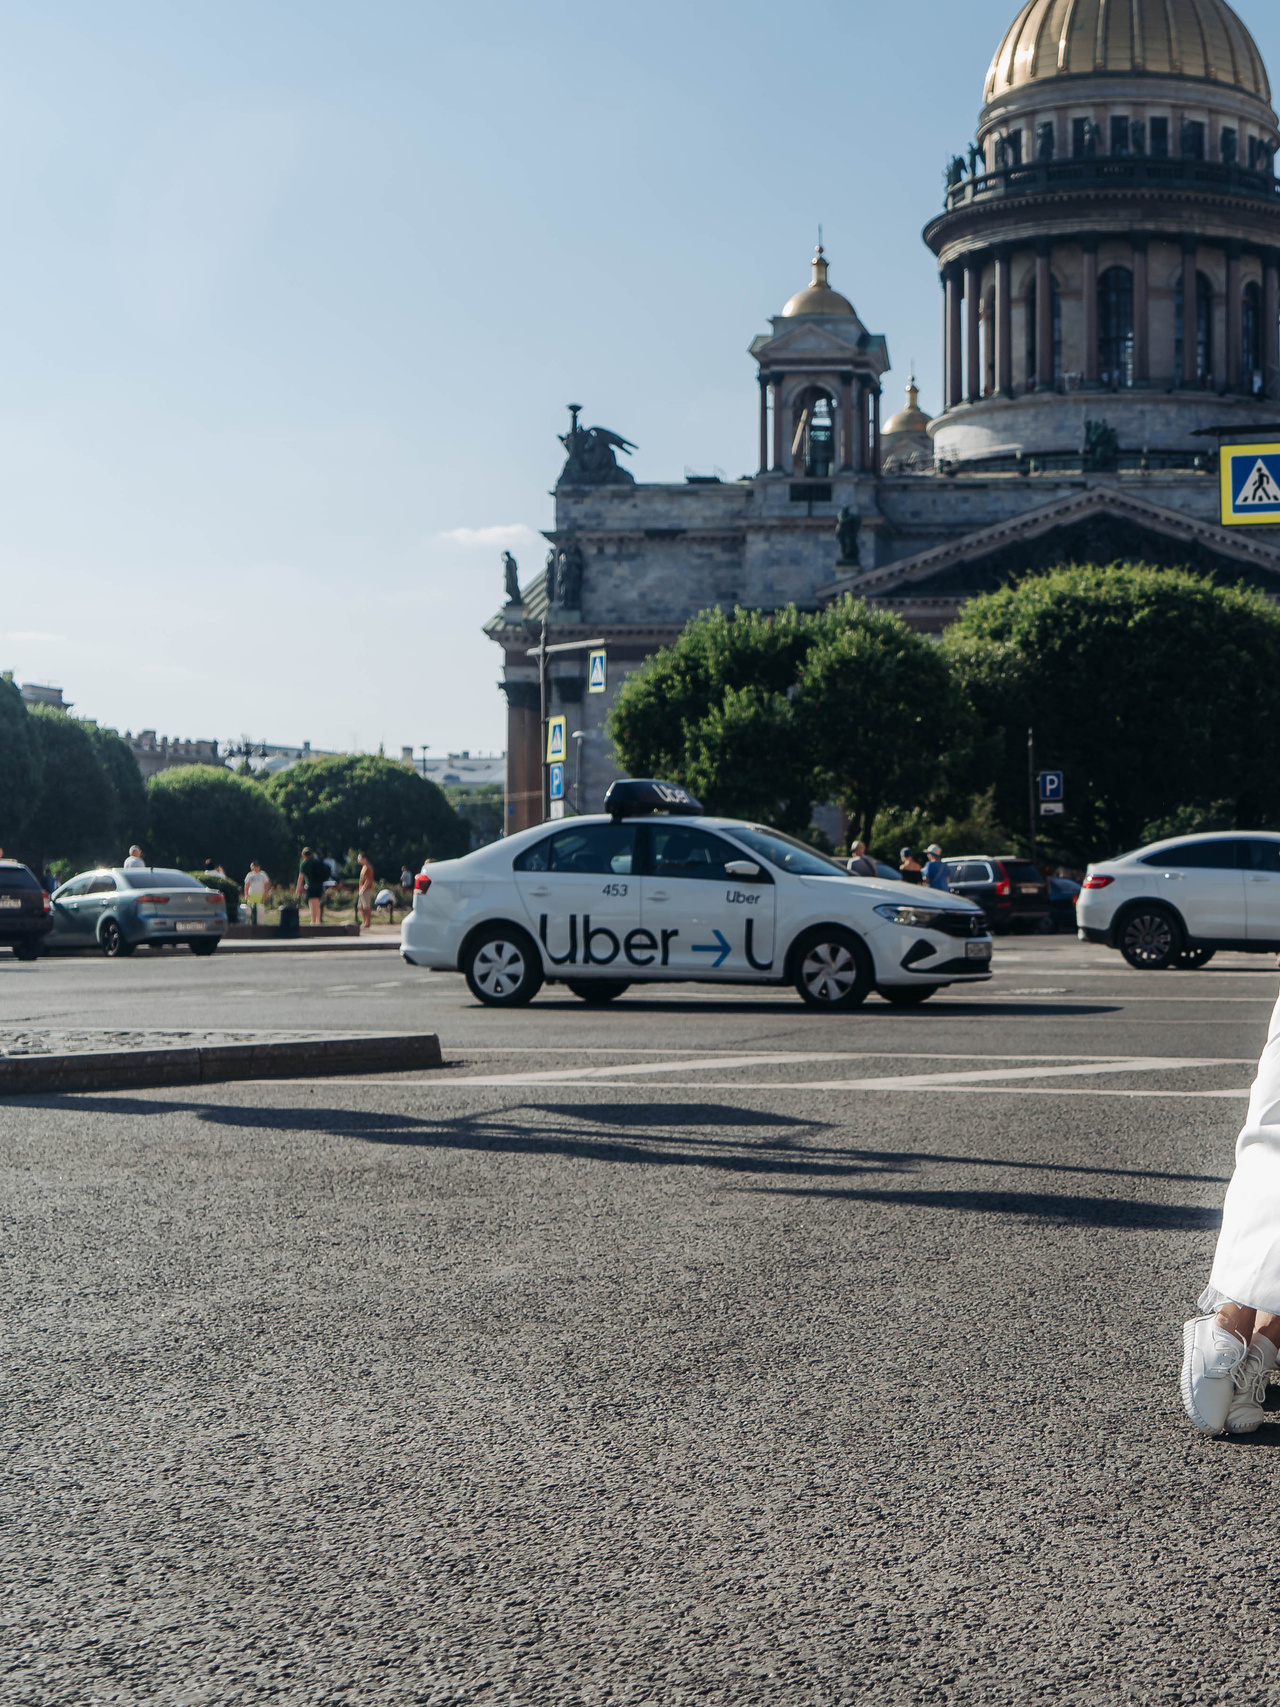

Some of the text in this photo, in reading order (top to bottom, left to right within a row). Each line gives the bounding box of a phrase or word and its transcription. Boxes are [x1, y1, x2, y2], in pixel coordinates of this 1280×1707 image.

[652, 783, 690, 803] Uber
[1046, 775, 1058, 796] P
[602, 884, 628, 897] 453
[726, 890, 761, 904] Uber
[539, 913, 679, 966] Uber
